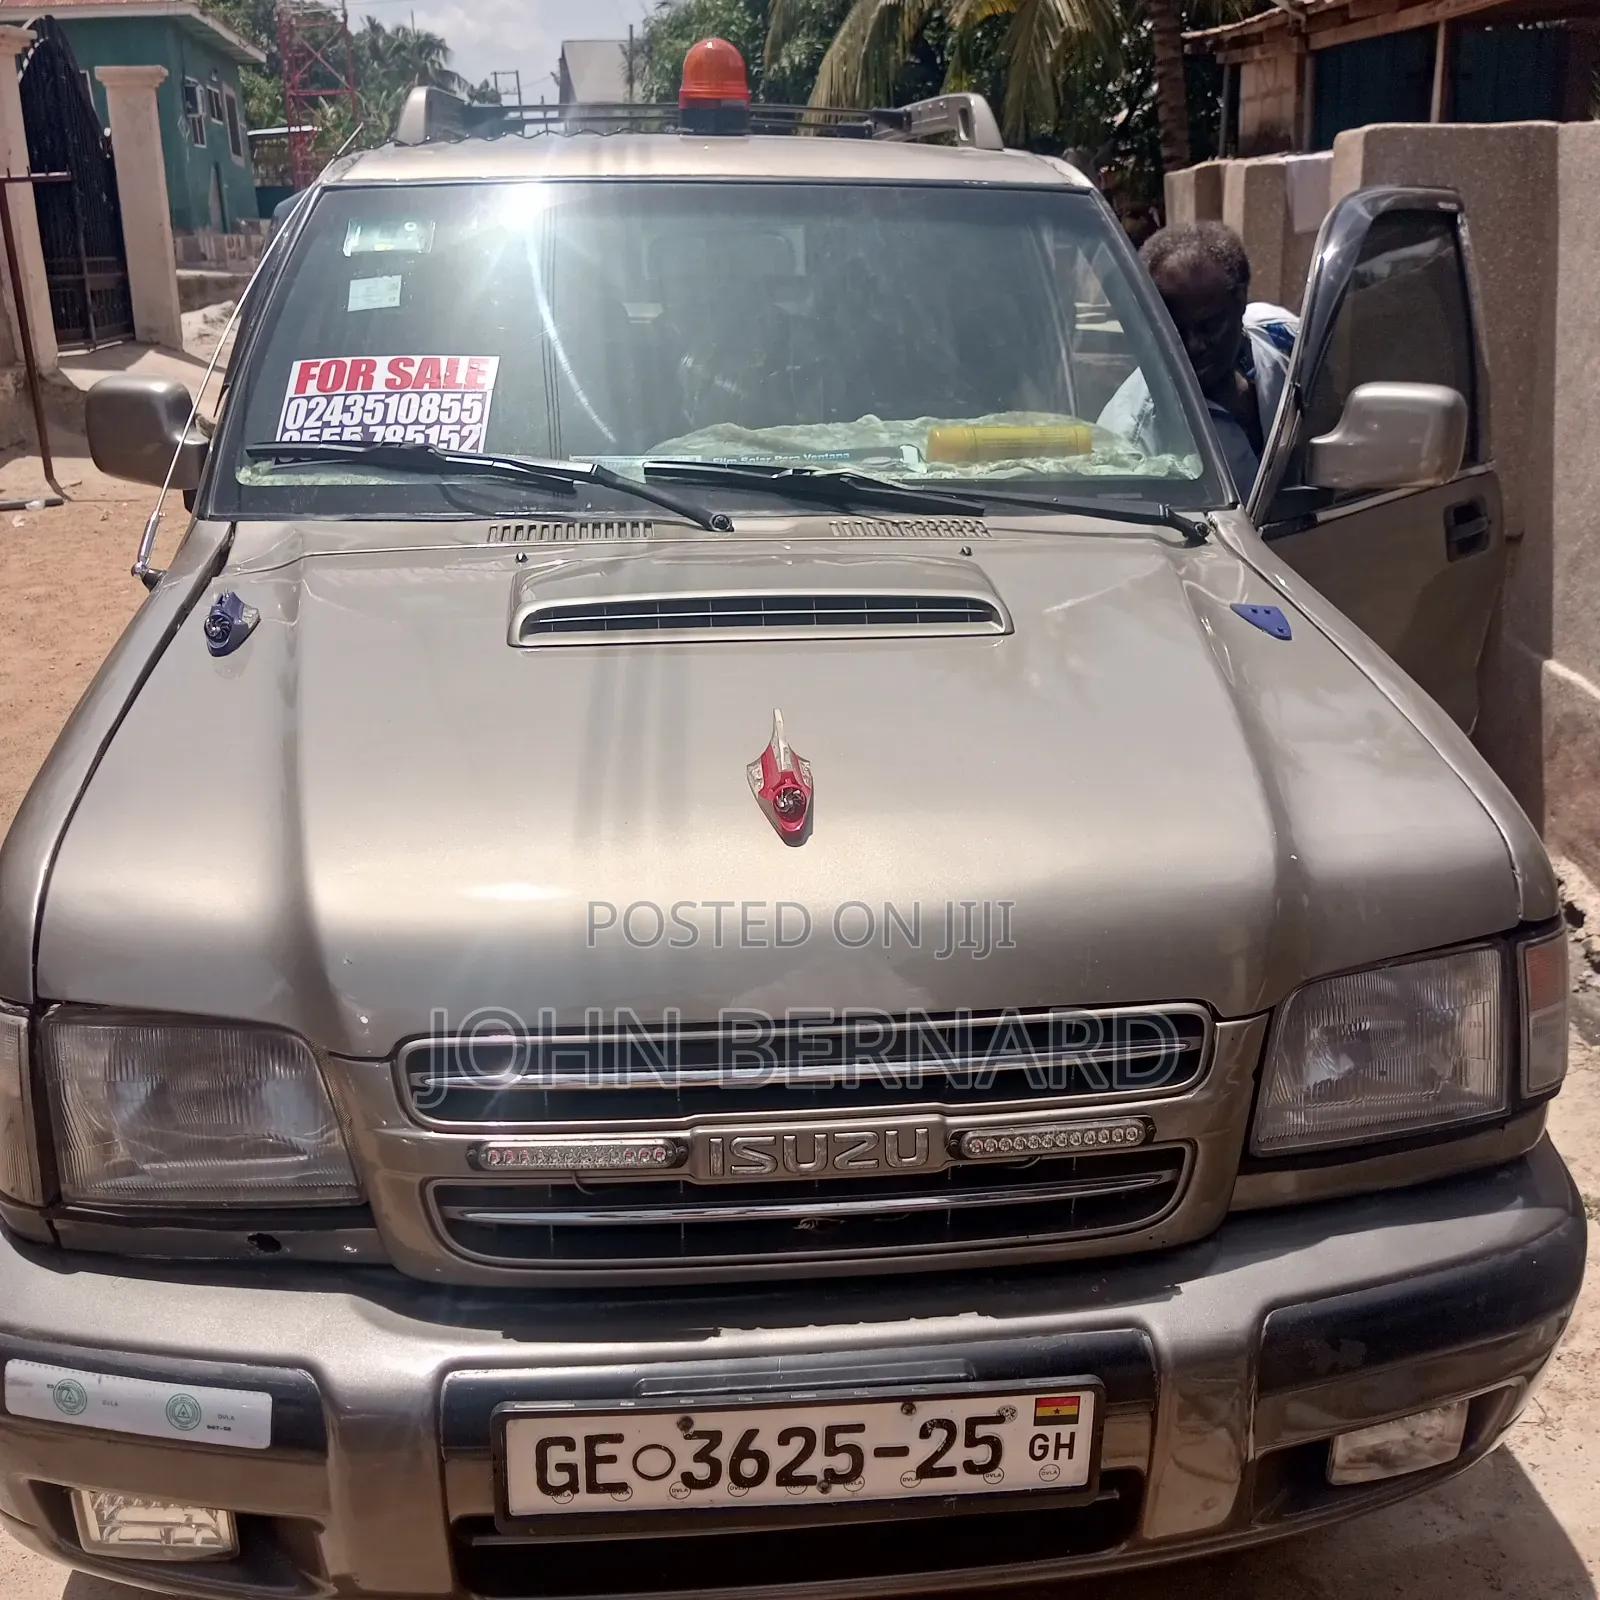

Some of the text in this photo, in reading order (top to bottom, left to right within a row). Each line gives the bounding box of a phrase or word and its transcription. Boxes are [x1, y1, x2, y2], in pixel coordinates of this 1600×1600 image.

[294, 357, 490, 395] FOR SALE
[284, 392, 483, 430] 0243510855
[803, 452, 850, 461] Ventana
[709, 1127, 930, 1177] ISUZU
[534, 1414, 1006, 1497] GE 3625-25
[1028, 1431, 1076, 1462] GH
